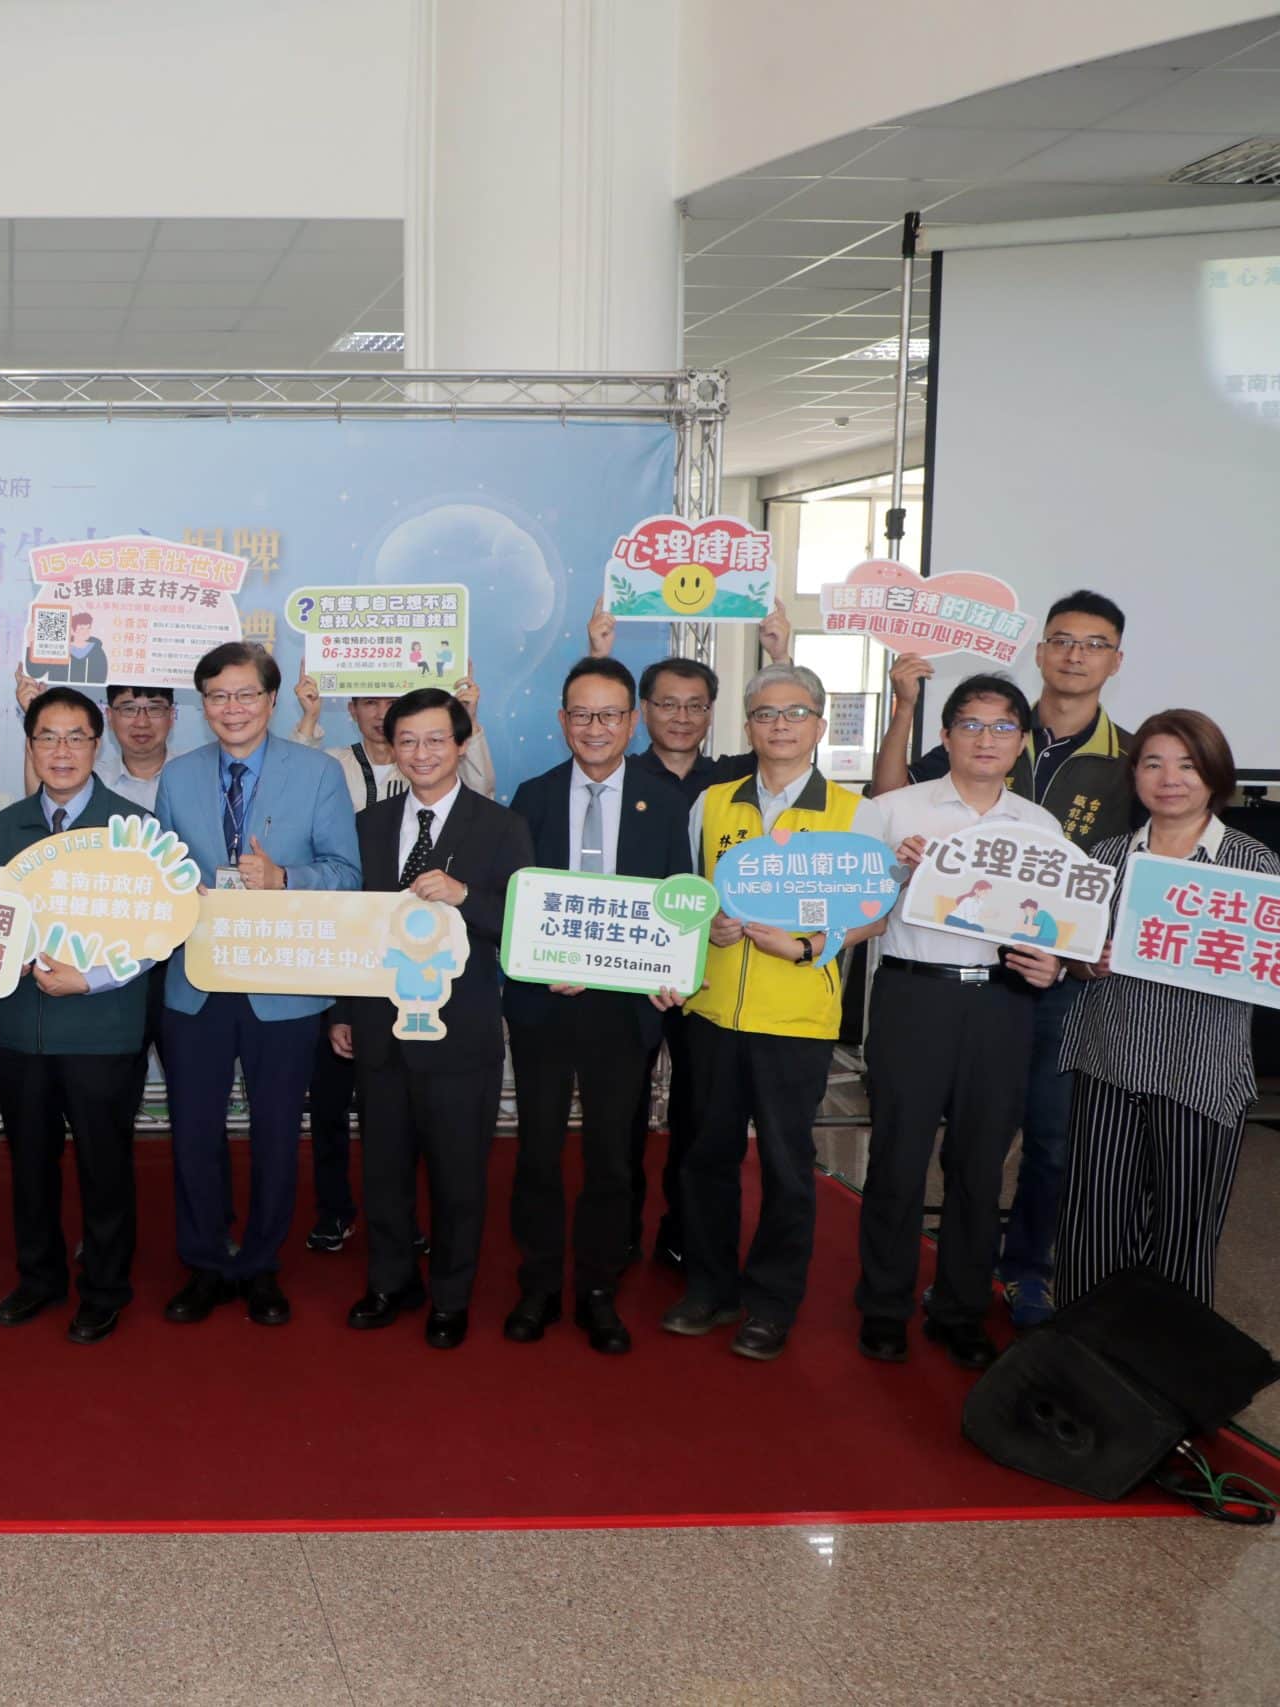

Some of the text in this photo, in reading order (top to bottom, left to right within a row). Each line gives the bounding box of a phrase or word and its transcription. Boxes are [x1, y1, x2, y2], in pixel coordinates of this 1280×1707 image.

[615, 529, 770, 571] 心理健康
[54, 577, 221, 609] 心理健康支持方案
[320, 594, 458, 612] 有些事自己想不透
[319, 613, 458, 630] 想找人又不知道找誰
[831, 586, 1025, 640] 酸甜苦辣的滋味
[826, 613, 1017, 663] 都有心衛中心的安慰
[322, 647, 402, 659] 06-3352982
[8, 816, 198, 892] INTO THE MIND
[737, 852, 886, 877] 台南心衛中心
[49, 869, 153, 896] 臺南市政府
[925, 838, 1112, 904] 心理諮商
[32, 893, 174, 921] 心理健康教育館
[542, 891, 651, 921] 臺南市社區
[663, 892, 707, 912] LINE
[211, 917, 338, 940] 臺南市麻豆區
[540, 916, 671, 948] 心理衛生中心
[212, 945, 383, 970] 社區心理衛生中心
[532, 948, 672, 974] LINE@ 1925tainan
